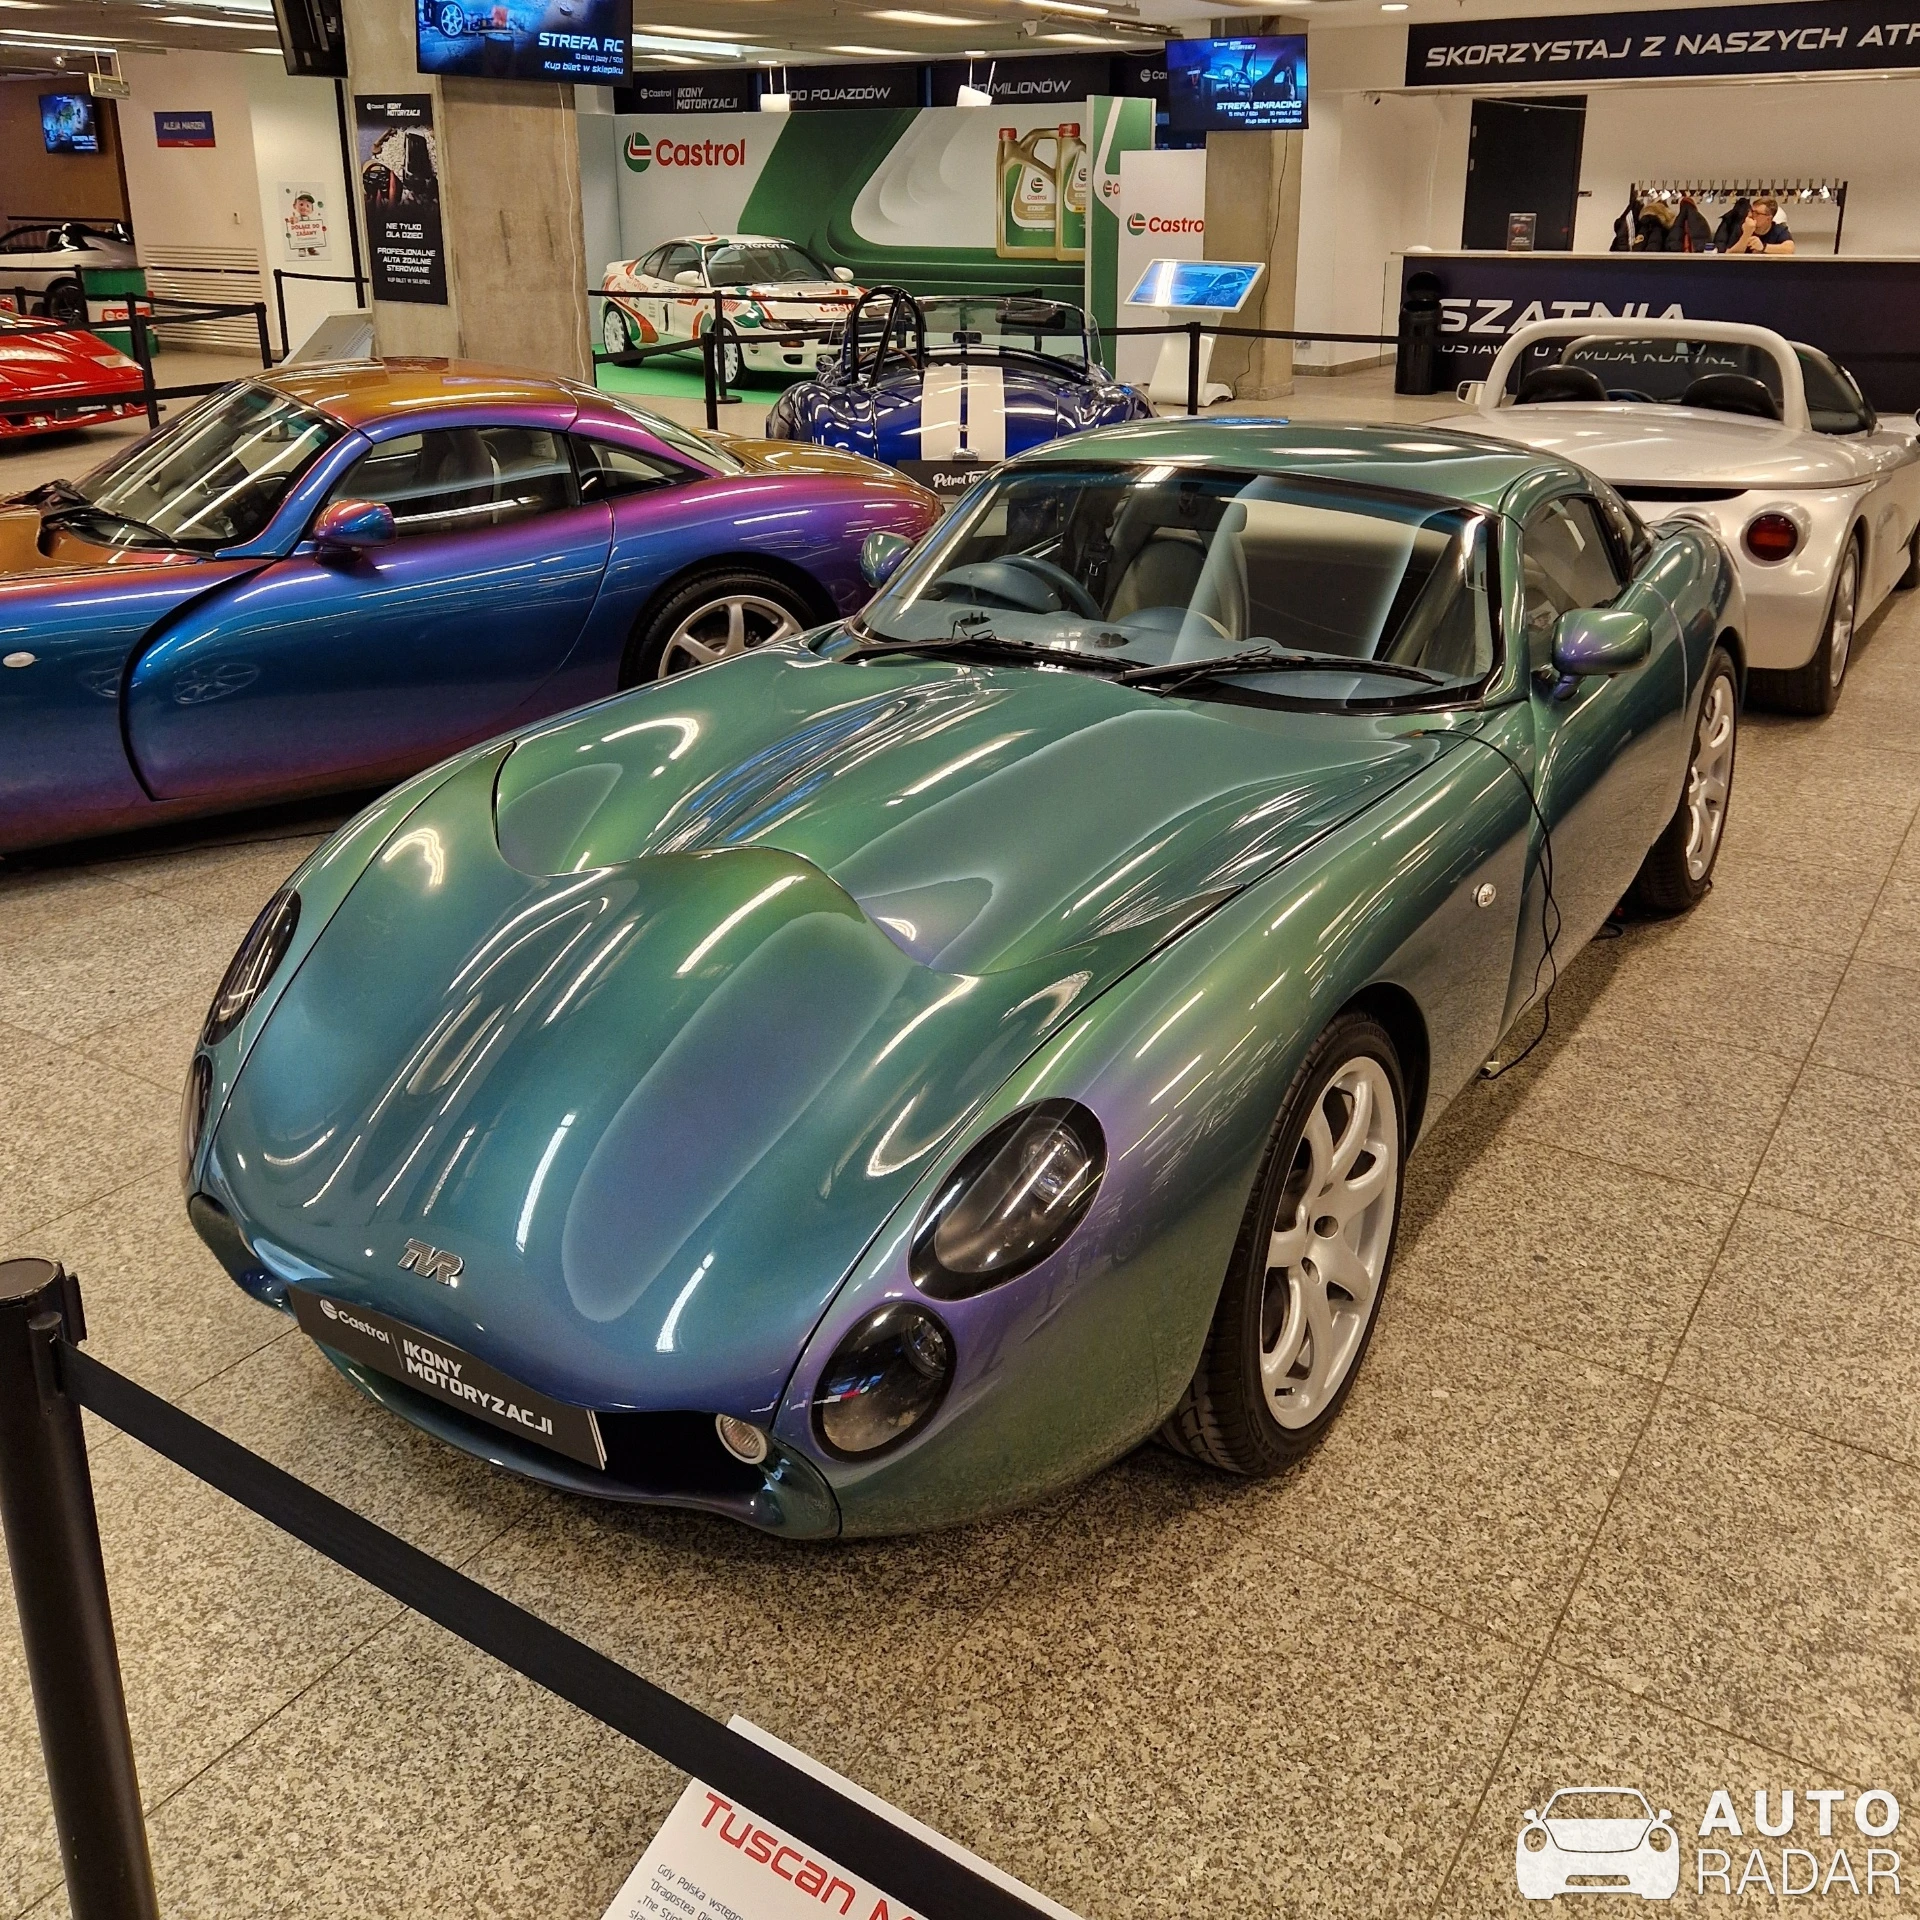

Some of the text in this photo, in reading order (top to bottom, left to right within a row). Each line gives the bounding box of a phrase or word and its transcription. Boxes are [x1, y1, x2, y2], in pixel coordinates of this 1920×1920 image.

[538, 32, 624, 53] STREFA RC
[1425, 37, 1633, 68] SKORZYSTAJ
[1639, 35, 1666, 57] Z
[1674, 26, 1848, 56] NASZYCH
[544, 61, 561, 71] Kup
[562, 62, 581, 72] bilet
[592, 65, 624, 75] sklepiku
[648, 87, 704, 98] Castrol IKONY
[811, 86, 891, 102] POJAZDÓW
[991, 78, 1072, 95] MILIONÓW
[676, 98, 738, 110] MOTORYZACJI
[1216, 100, 1302, 110] STREFA SIMRACING
[655, 138, 746, 167] Castrol
[385, 222, 422, 231] NIE TYLKO
[1149, 216, 1204, 233] Castro
[377, 247, 436, 257] PROFESJONALNE
[386, 264, 430, 273] STEROWANE
[402, 257, 432, 265] ZDALNIE
[932, 472, 966, 488] Petrol
[398, 1237, 465, 1286] TVR
[337, 1309, 391, 1345] Castrol
[402, 1338, 463, 1379] IKONY
[406, 1360, 554, 1436] MOTORYZACJI
[701, 1791, 857, 1916] Tuscan
[657, 1863, 676, 1881] Gdy
[677, 1876, 707, 1901] Polska
